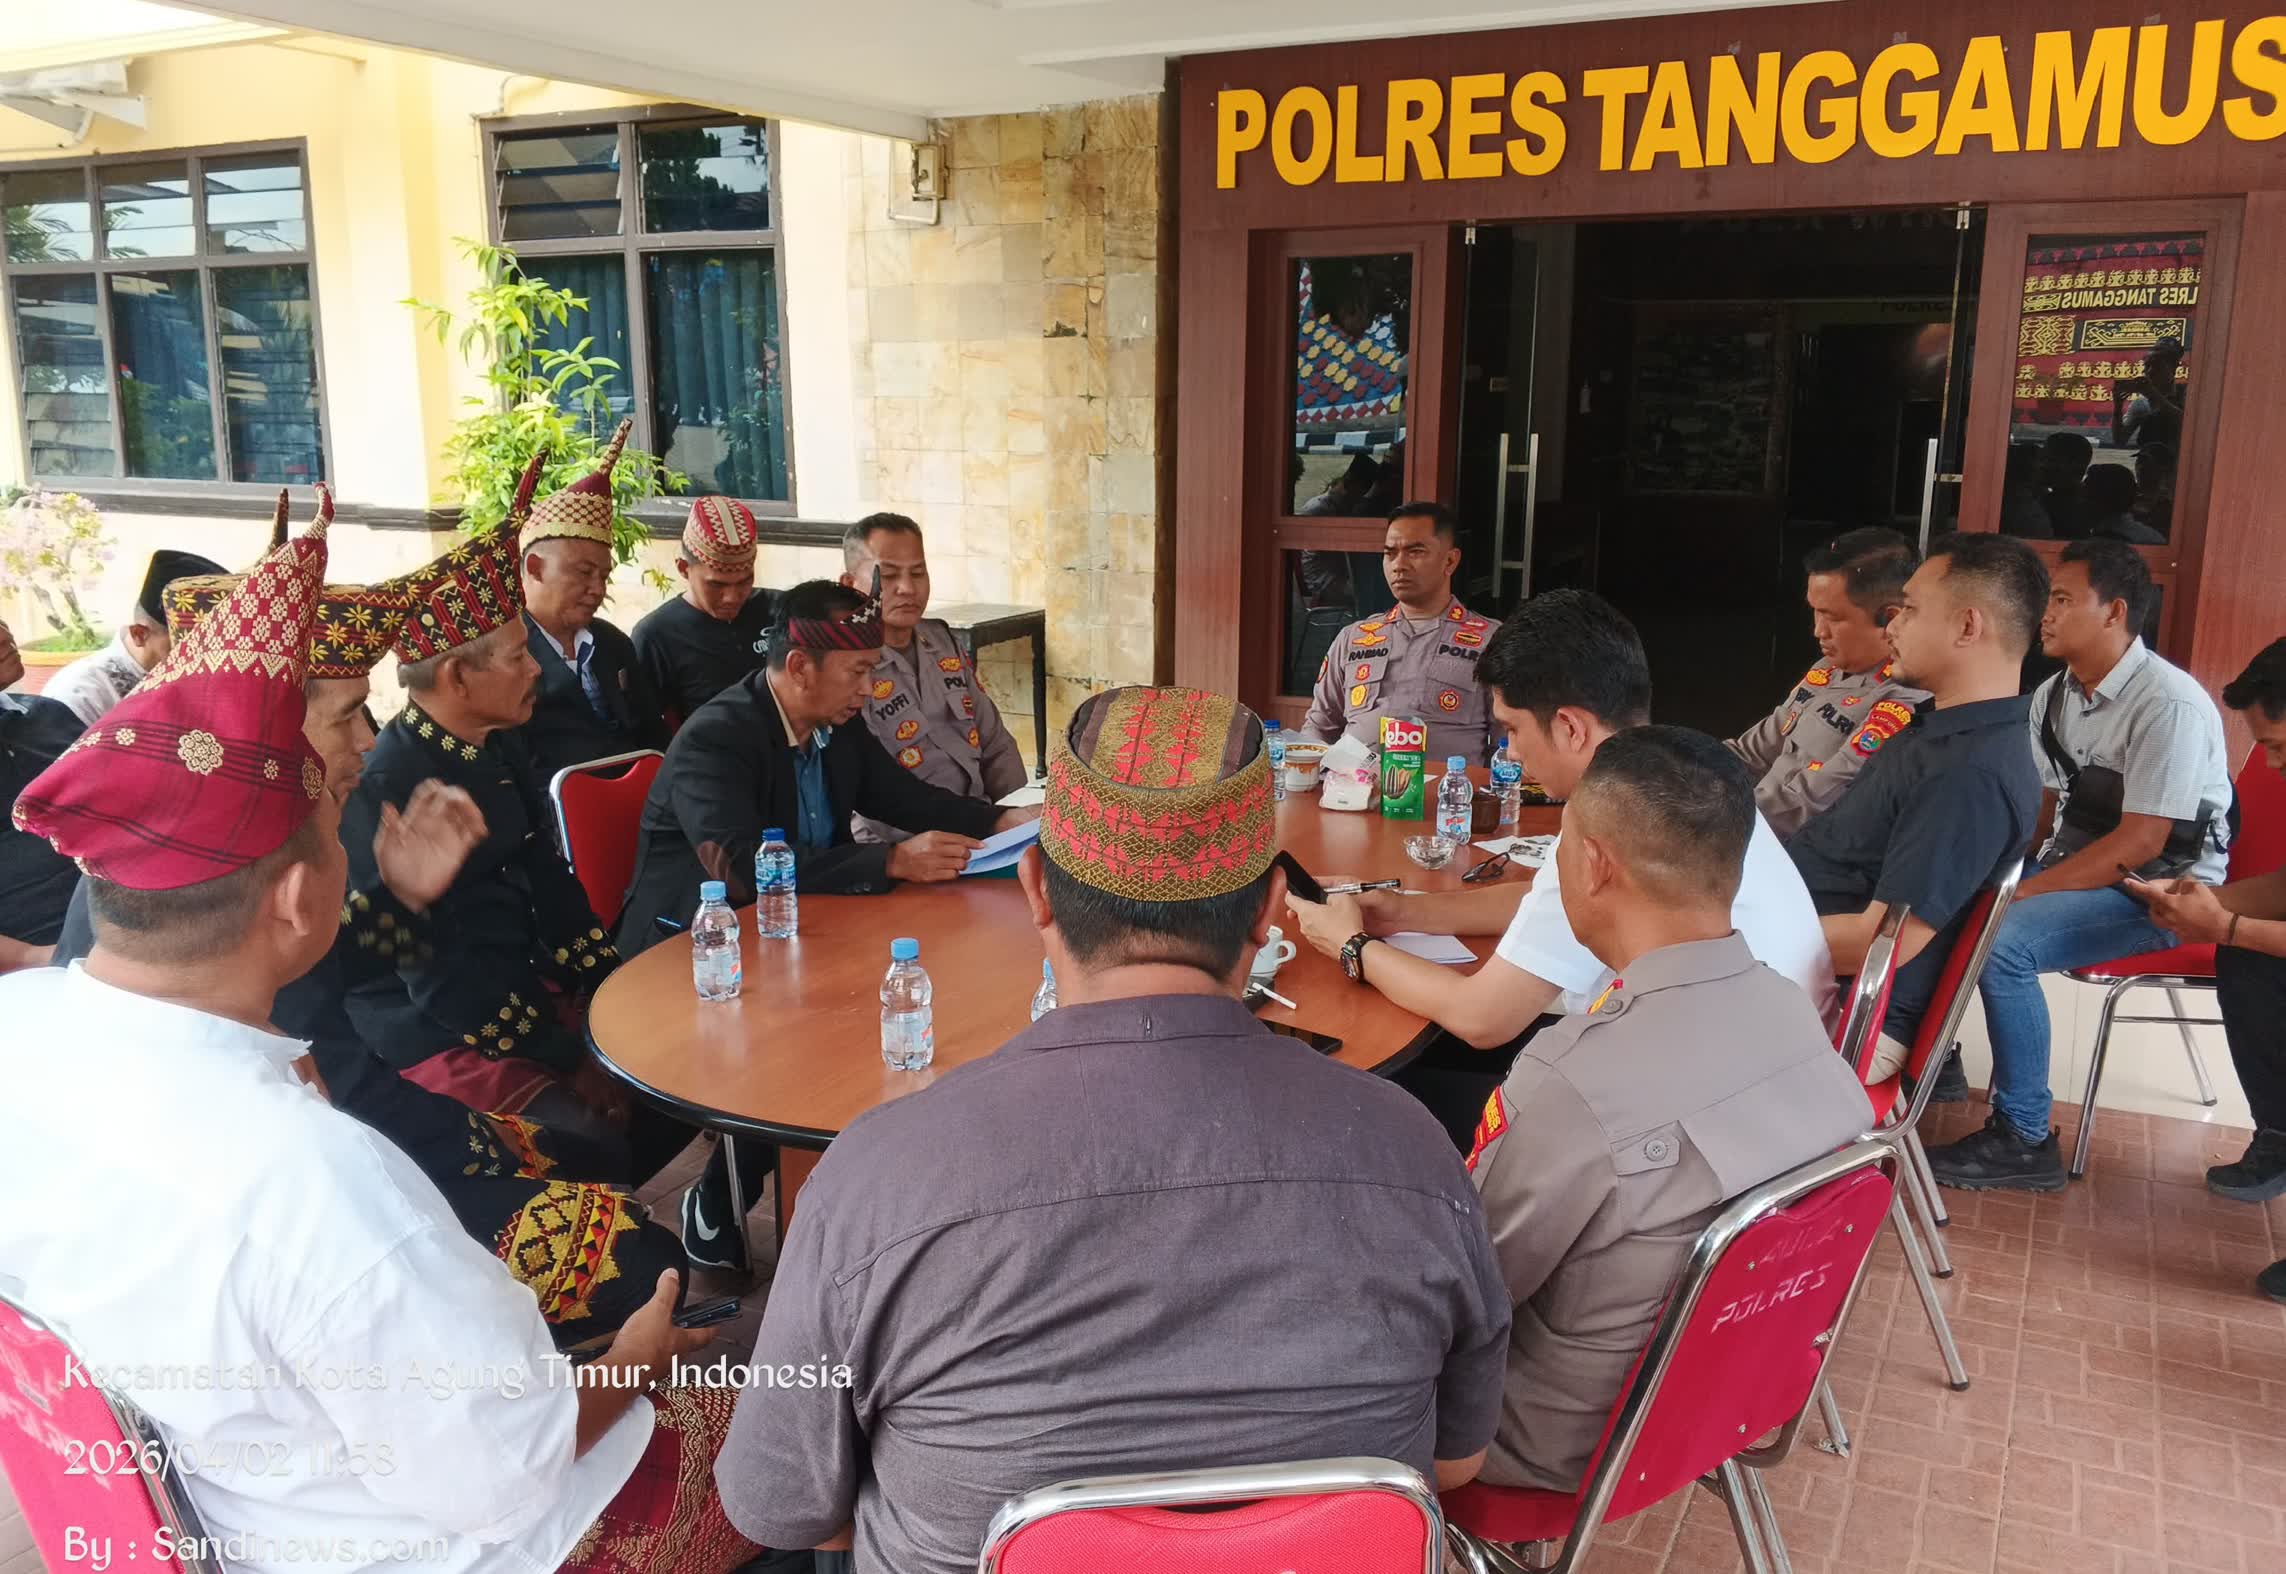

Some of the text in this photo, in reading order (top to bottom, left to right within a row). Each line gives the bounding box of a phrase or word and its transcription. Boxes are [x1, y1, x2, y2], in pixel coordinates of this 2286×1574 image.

[1217, 16, 2286, 189] POLRES TANGGAMUS
[1439, 644, 1482, 660] POLR
[876, 693, 910, 721] YOFFI
[1711, 1262, 1833, 1334] POLRES
